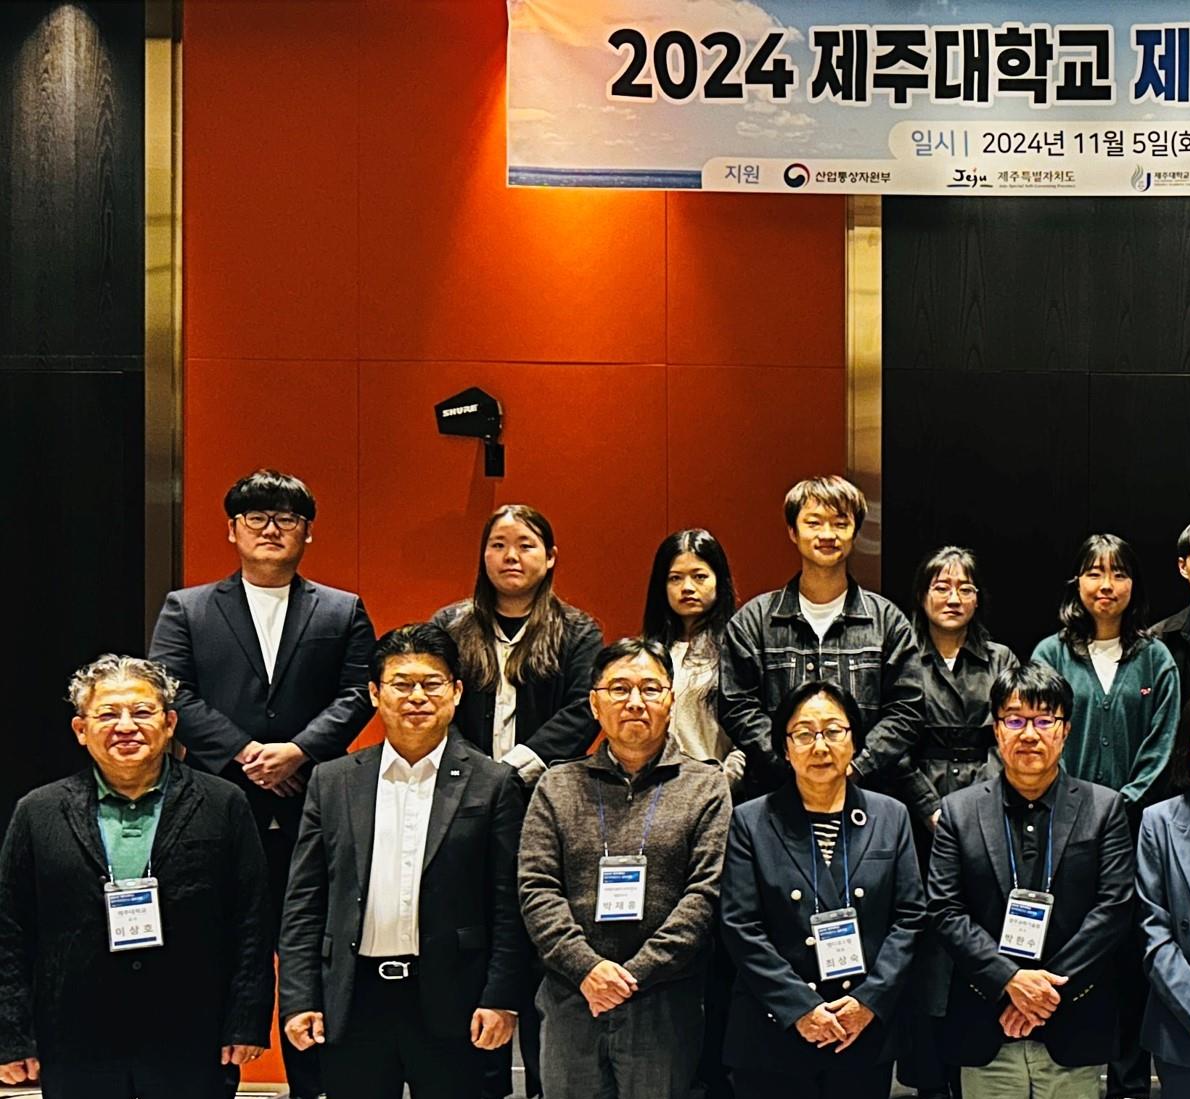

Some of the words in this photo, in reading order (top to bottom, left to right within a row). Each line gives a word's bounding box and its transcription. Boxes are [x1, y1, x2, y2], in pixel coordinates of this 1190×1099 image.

[609, 28, 794, 101] 2024
[811, 26, 1112, 104] 제주대학교
[982, 130, 1065, 157] 2024년
[1074, 130, 1125, 157] 11월
[725, 164, 760, 185] 지원
[815, 171, 891, 183] 산업통상자원부
[952, 167, 987, 188] Jeju
[997, 170, 1076, 182] 제주특별자치도
[442, 403, 479, 418] SHURE
